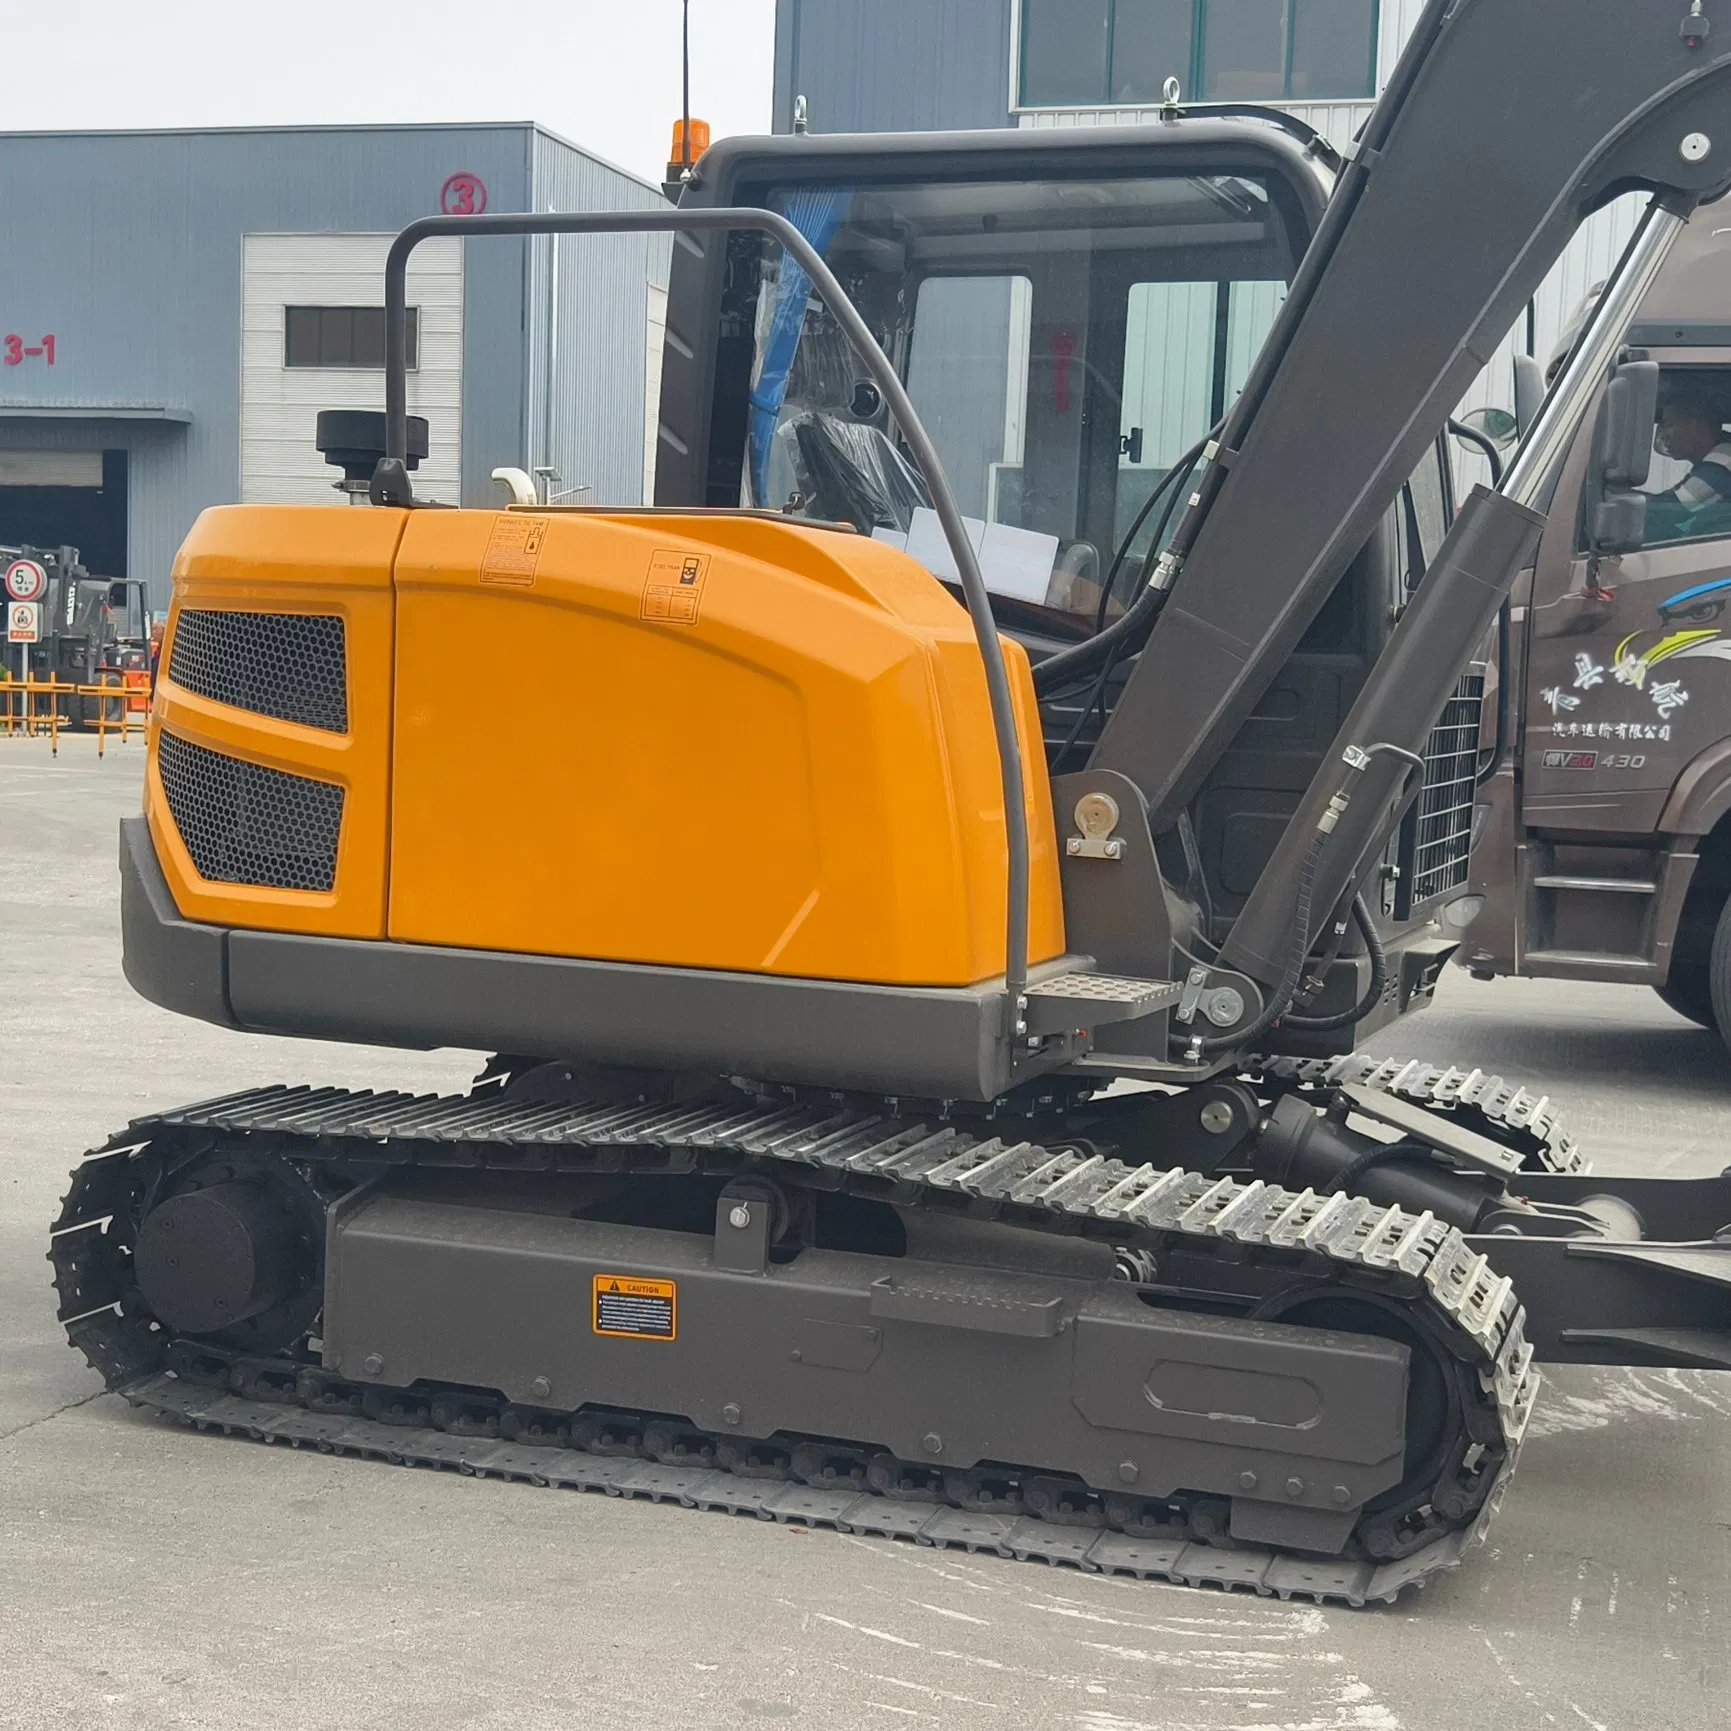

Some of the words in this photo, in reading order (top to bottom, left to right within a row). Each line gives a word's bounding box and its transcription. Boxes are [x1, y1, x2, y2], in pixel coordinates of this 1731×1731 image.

[4, 334, 55, 366] 3-1
[1600, 754, 1646, 769] 430
[626, 1284, 660, 1294] CAUTION
